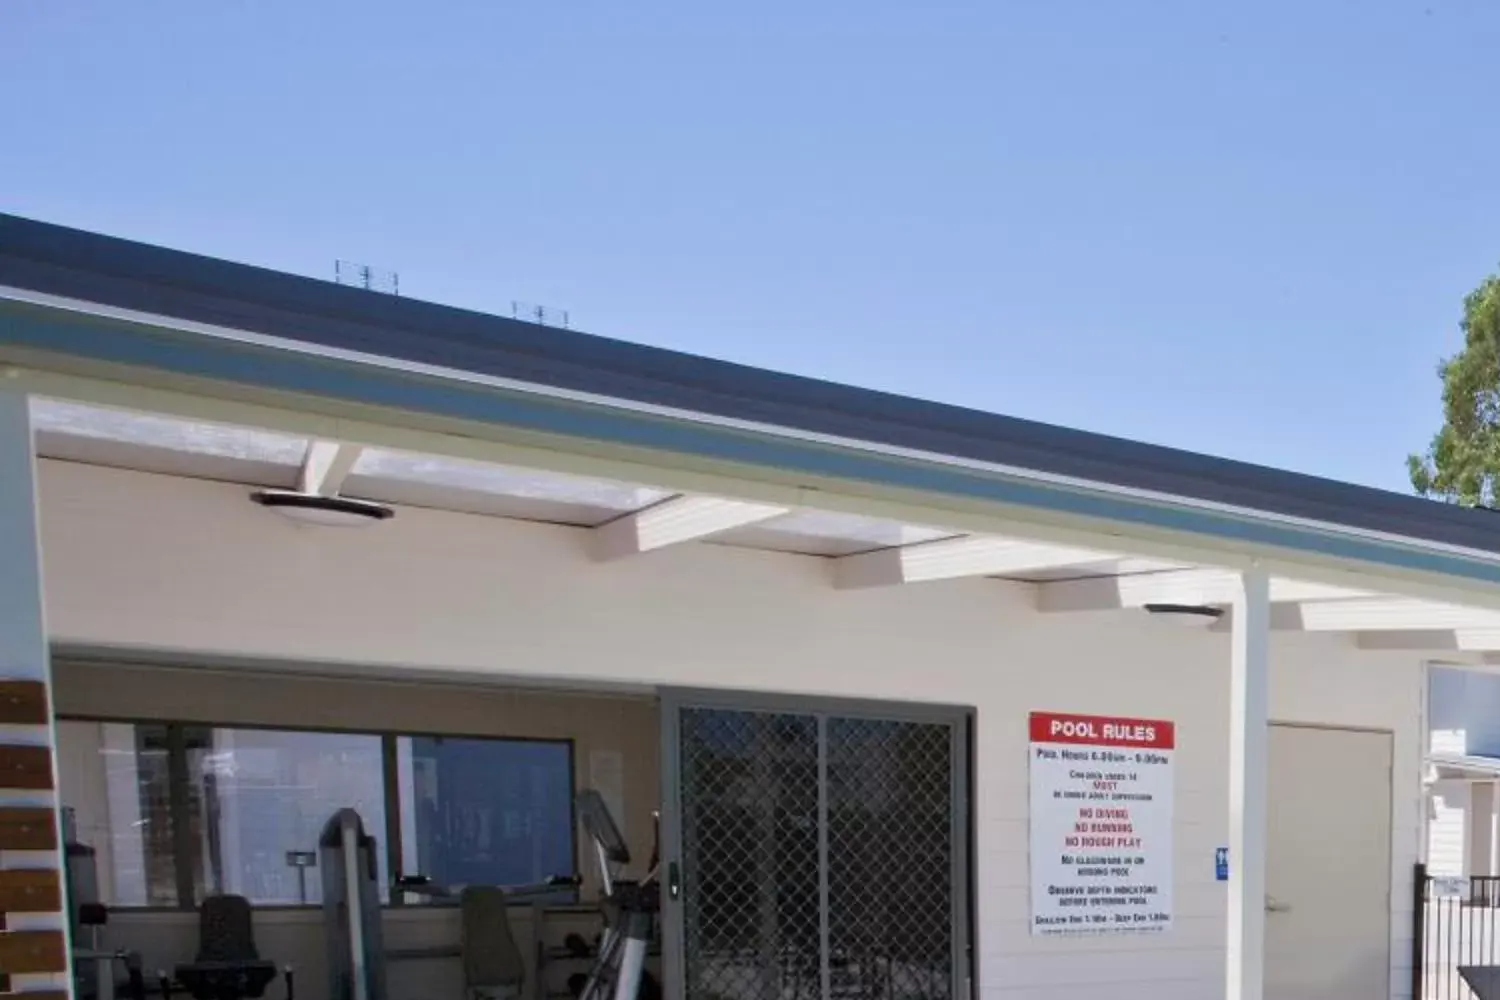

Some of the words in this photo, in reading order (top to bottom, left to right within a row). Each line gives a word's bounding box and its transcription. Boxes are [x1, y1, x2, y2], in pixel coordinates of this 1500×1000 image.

[1051, 720, 1098, 738] POOL
[1104, 724, 1155, 741] RULES
[1093, 781, 1118, 790] MUST
[1079, 808, 1093, 818] NO
[1095, 808, 1128, 819] DIVING
[1075, 822, 1088, 832] NO
[1091, 823, 1133, 833] RUNNING
[1065, 837, 1079, 847] NO
[1081, 837, 1115, 848] ROUGH
[1117, 838, 1141, 848] PLAY
